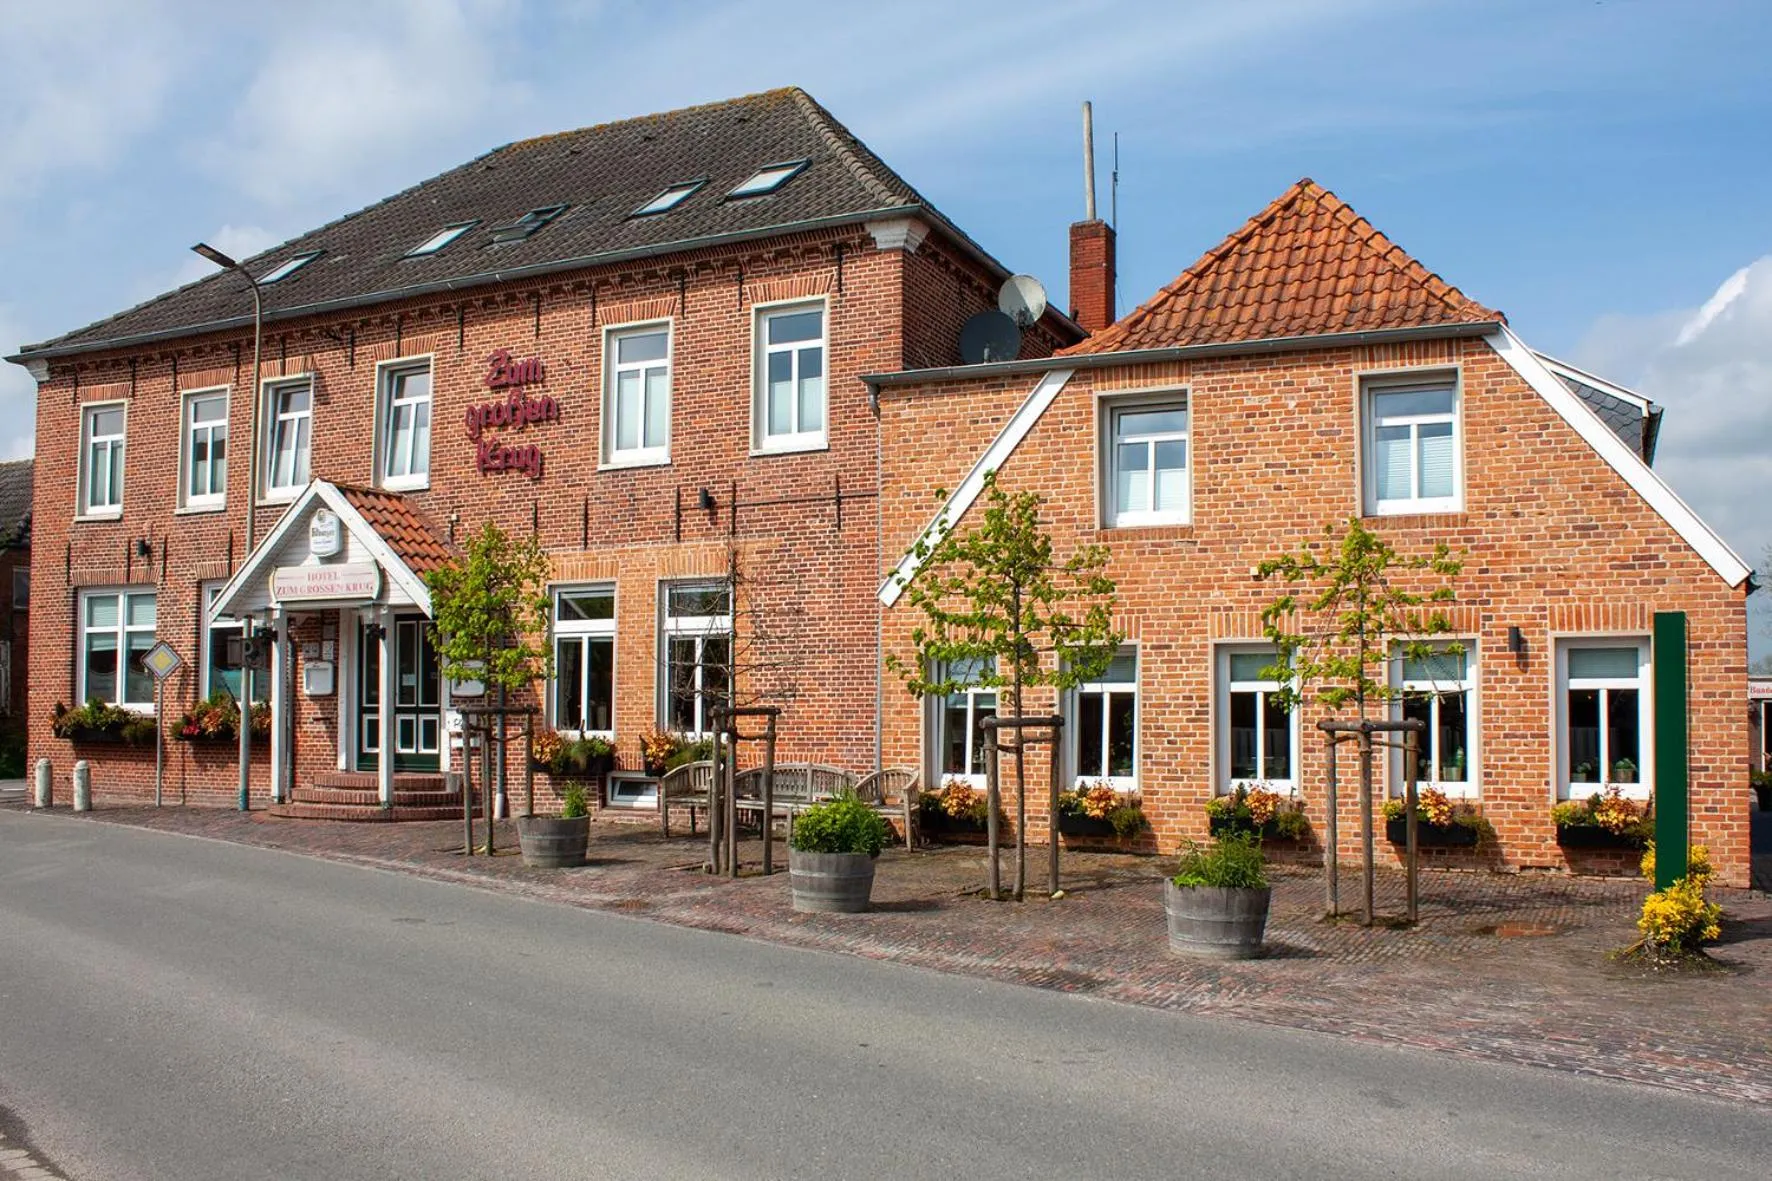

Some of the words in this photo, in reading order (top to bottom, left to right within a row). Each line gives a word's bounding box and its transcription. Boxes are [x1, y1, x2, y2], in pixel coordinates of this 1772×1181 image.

[485, 350, 544, 387] Zum
[465, 387, 559, 440] großen
[477, 437, 542, 479] Krug
[277, 584, 298, 596] ZUM
[299, 582, 343, 594] GROSSEN
[345, 582, 374, 592] KRUG
[307, 571, 338, 582] HOTEL
